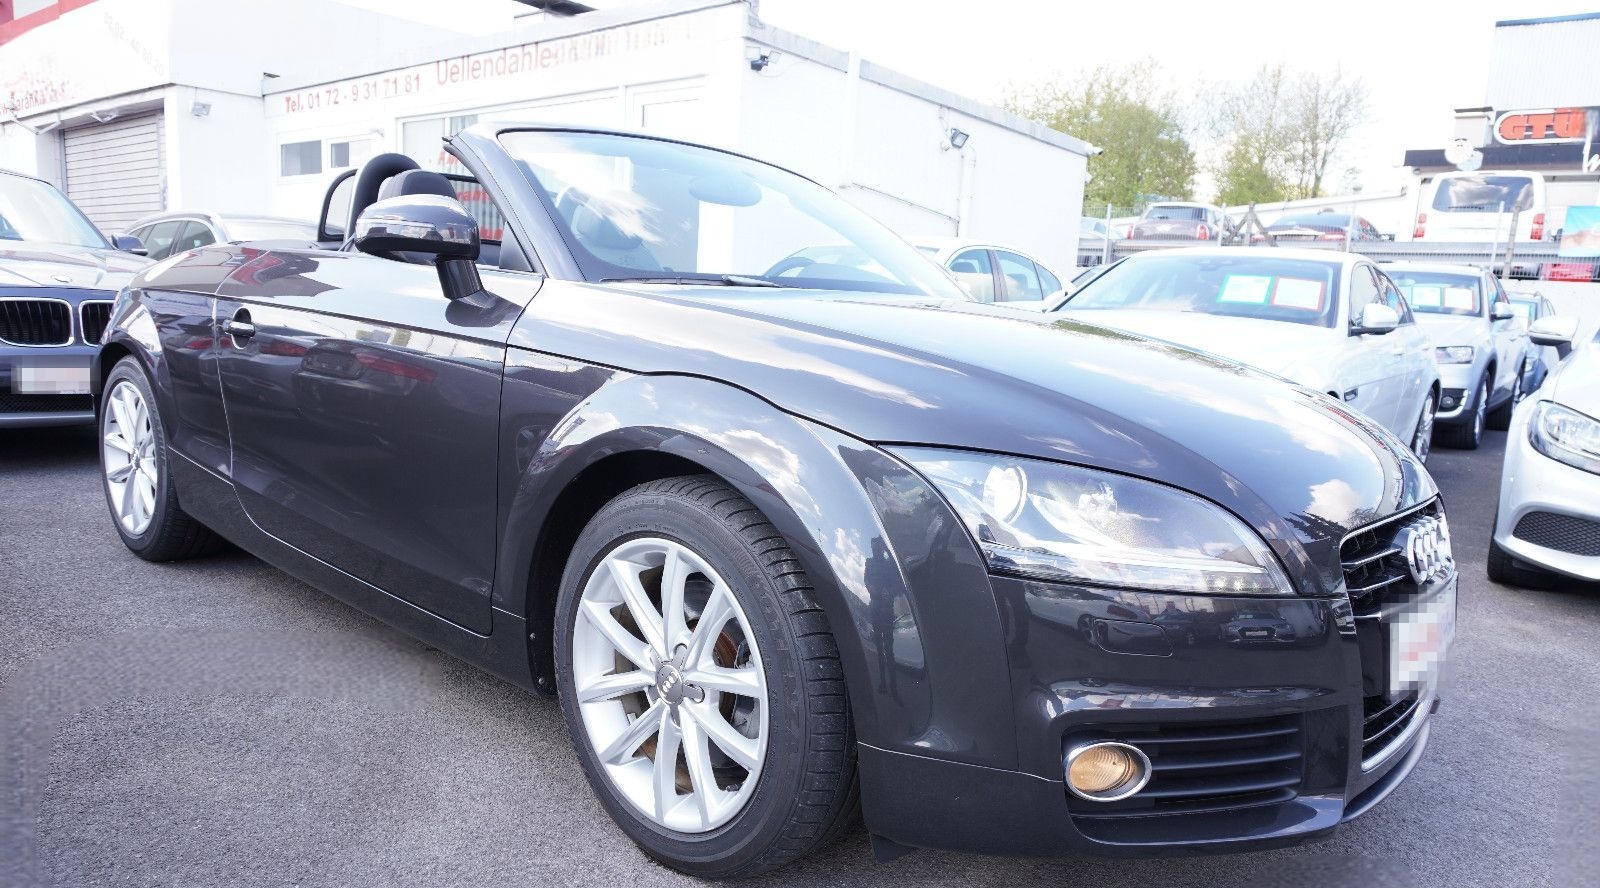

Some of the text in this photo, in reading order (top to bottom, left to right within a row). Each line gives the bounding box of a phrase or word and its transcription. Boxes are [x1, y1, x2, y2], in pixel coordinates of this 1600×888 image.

[285, 94, 304, 112] Tel.
[308, 93, 321, 109] 01
[326, 88, 339, 106] 72
[352, 84, 359, 102] 9
[363, 80, 378, 100] 31
[384, 77, 398, 96] 71
[405, 73, 420, 93] 81
